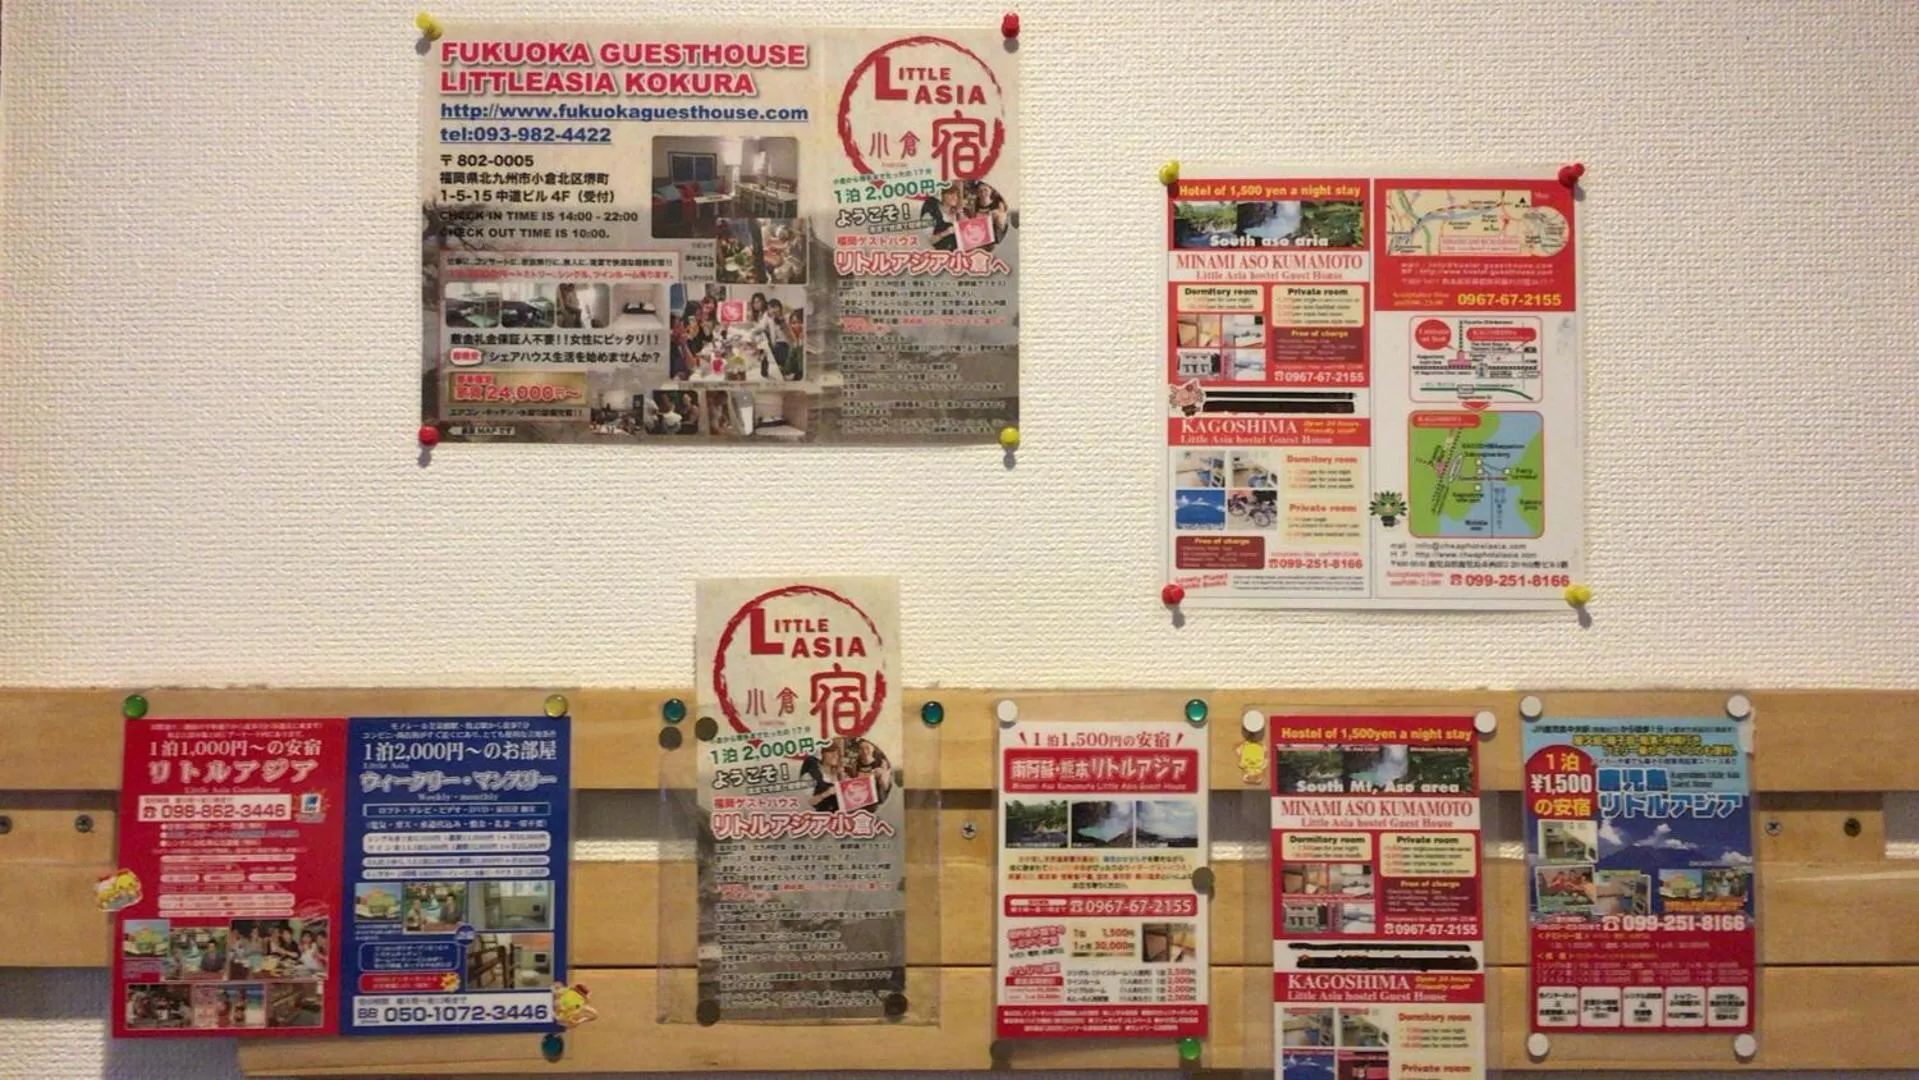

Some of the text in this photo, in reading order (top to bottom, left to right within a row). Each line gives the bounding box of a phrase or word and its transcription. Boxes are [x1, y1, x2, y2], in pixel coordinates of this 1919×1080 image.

[441, 42, 806, 66] FUKUOKA GUESTHOUSE
[441, 72, 755, 95] LITTLEASIA KOKURA
[875, 56, 952, 100] LITTLE
[915, 85, 987, 104] ASIA
[441, 104, 808, 121] http://www.fukuokaguesthouse.com
[441, 128, 611, 143] tel:093-982-4422
[869, 131, 920, 158] 小倉
[931, 110, 986, 181] 宿
[458, 155, 534, 167] 802-0005
[440, 189, 545, 202] 1-5-15 中道ビル
[1180, 186, 1211, 195] Hotel
[1214, 185, 1226, 195] of
[1231, 185, 1262, 197] 1,500
[1266, 187, 1287, 197] yen
[1301, 185, 1331, 197] night
[1335, 185, 1360, 197] stay
[488, 212, 502, 221] IN
[506, 212, 538, 221] TIME
[542, 212, 554, 221] IS
[559, 212, 592, 221] 14:00
[604, 212, 638, 221] 22:00
[489, 228, 515, 238] OUT
[520, 228, 552, 238] TIME
[556, 229, 567, 238] IS
[1210, 235, 1328, 246] South aso aria
[835, 250, 1010, 276] リトルアジア小倉へ
[1177, 255, 1362, 269] MINAMI ASO KUMAMOTO
[1197, 272, 1223, 280] Little
[1227, 272, 1246, 280] Asia
[1282, 272, 1308, 280] Guest
[1313, 272, 1342, 280] House
[1185, 288, 1231, 297] Dormitory
[1457, 294, 1561, 306] 0967-67-2155
[1181, 420, 1297, 433] KAGOSHIMA
[1181, 435, 1333, 444] Little Asia hostel Guest House
[1466, 574, 1570, 587] 099-251-8166
[750, 608, 829, 655] LITTLE
[792, 637, 866, 658] ASIA
[746, 687, 799, 716] 小倉
[810, 662, 868, 739] 宿
[1281, 728, 1323, 739] Hostel
[1325, 728, 1338, 739] of
[1400, 730, 1407, 739] a
[1410, 728, 1443, 741] night
[1447, 728, 1472, 741] stay
[1547, 753, 1580, 771] 1泊
[148, 758, 319, 784] リトルアジア
[1296, 780, 1344, 792] South
[1384, 780, 1415, 792] Aso
[1420, 782, 1459, 792] area
[1531, 774, 1592, 795] ¥1,500
[1281, 801, 1472, 816] MINAMI ASO KUMAMOTO
[1534, 798, 1591, 817] の安宿
[1598, 792, 1742, 818] リトルアジア
[711, 811, 895, 839] リトルアジア小倉へ
[1302, 819, 1329, 827] Little
[1333, 819, 1354, 827] Asia
[1389, 819, 1419, 827] Guest
[1422, 819, 1454, 827] House
[1289, 835, 1338, 845] Dormitory
[1397, 835, 1431, 844] Private
[1086, 900, 1192, 913] 0967-67-2155
[1396, 924, 1478, 935] 0967-67-2155
[1622, 915, 1746, 931] 099-251-8166
[1287, 975, 1410, 990] KAGOSHIMA
[1287, 991, 1448, 1001] Little Asia hostel Guest House
[385, 1004, 548, 1022] 050-1072-3446
